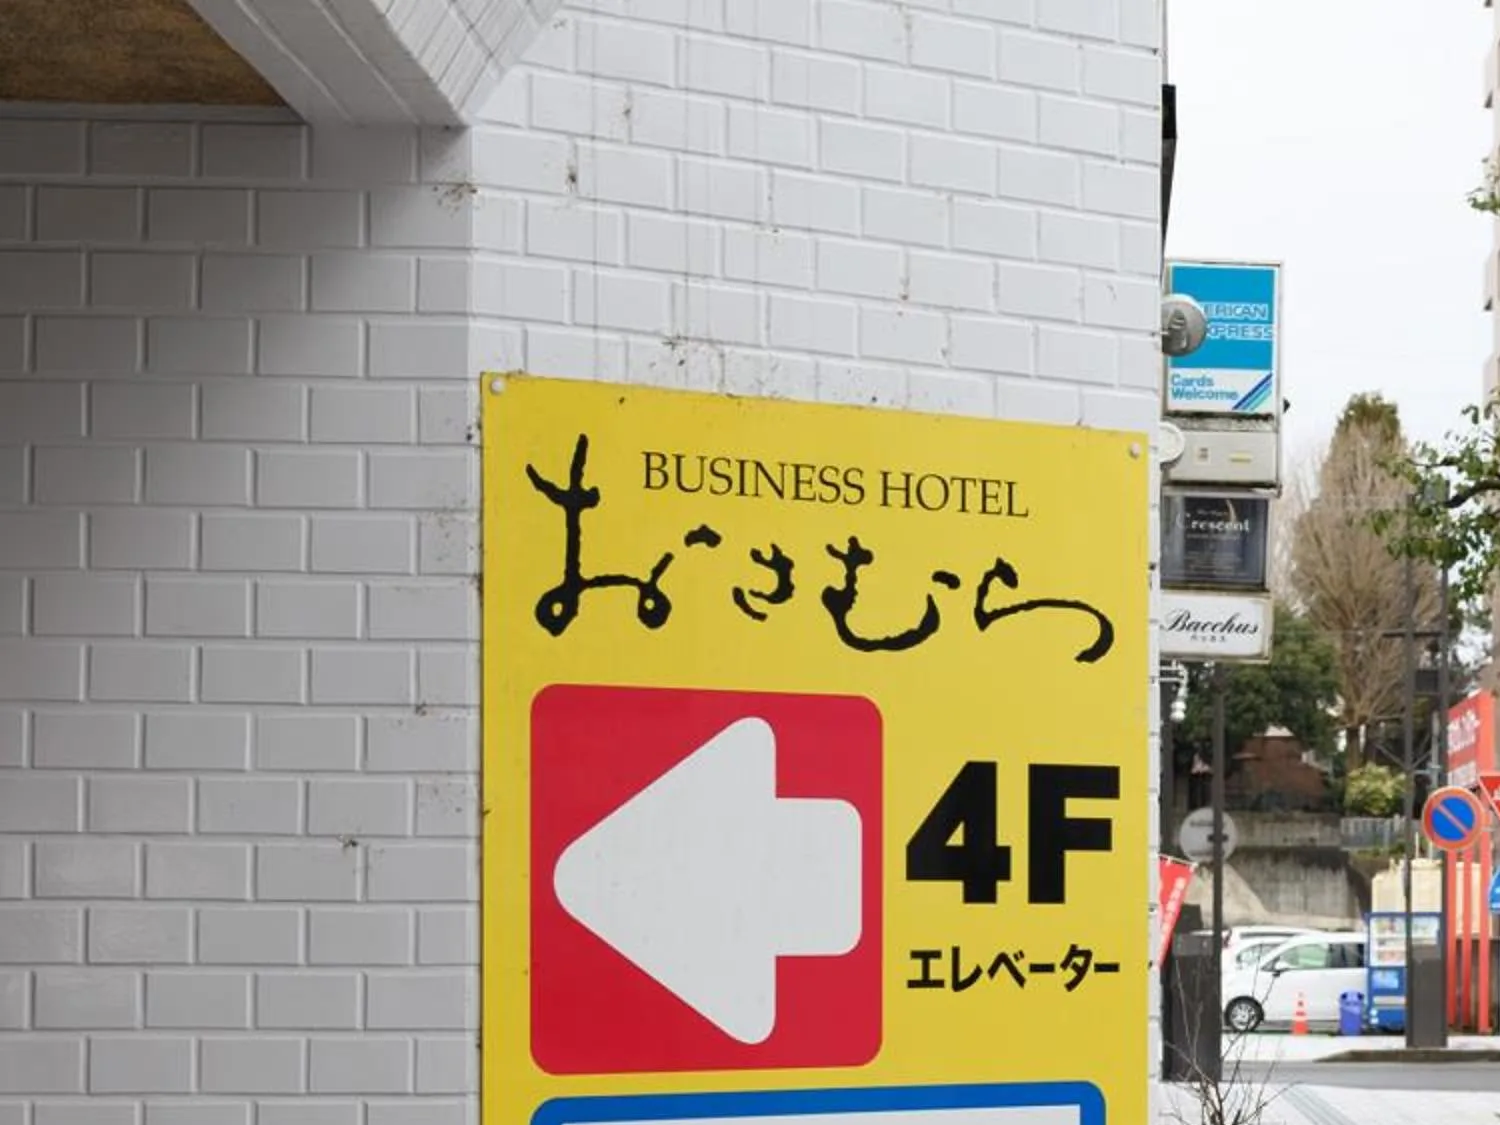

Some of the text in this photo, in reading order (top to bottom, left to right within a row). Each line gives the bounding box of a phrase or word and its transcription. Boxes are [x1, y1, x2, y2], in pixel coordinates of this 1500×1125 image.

[1171, 374, 1214, 388] Cards
[1171, 386, 1239, 400] Welcome
[642, 451, 1029, 518] BUSINESS HOTEL
[525, 433, 1114, 663] おさむら
[1160, 608, 1259, 635] Bacchus
[905, 760, 1120, 905] 4F
[907, 944, 1120, 992] エレベーター
